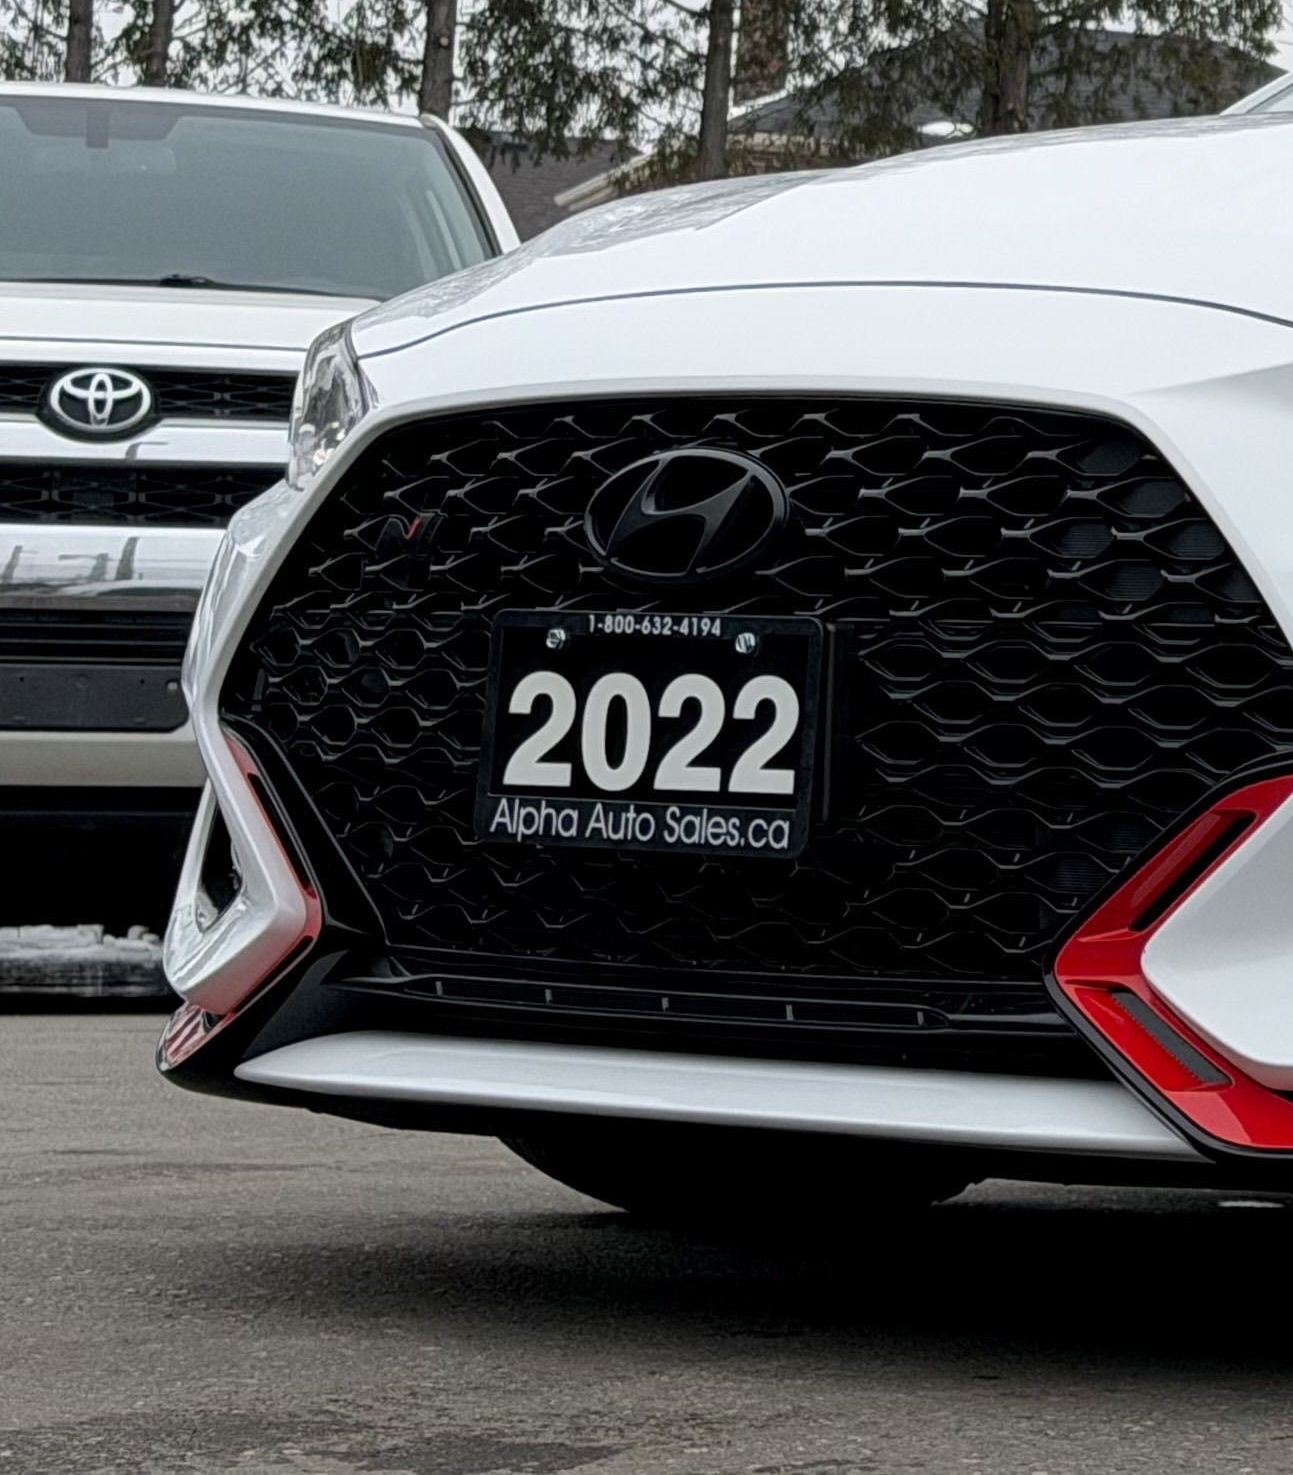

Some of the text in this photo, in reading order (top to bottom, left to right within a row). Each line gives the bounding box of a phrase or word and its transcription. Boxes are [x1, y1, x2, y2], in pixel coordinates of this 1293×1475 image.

[588, 614, 722, 637] 1-800-632-4194
[502, 670, 800, 795] 2022
[489, 796, 791, 850] Alpha Auto Sales.ca
